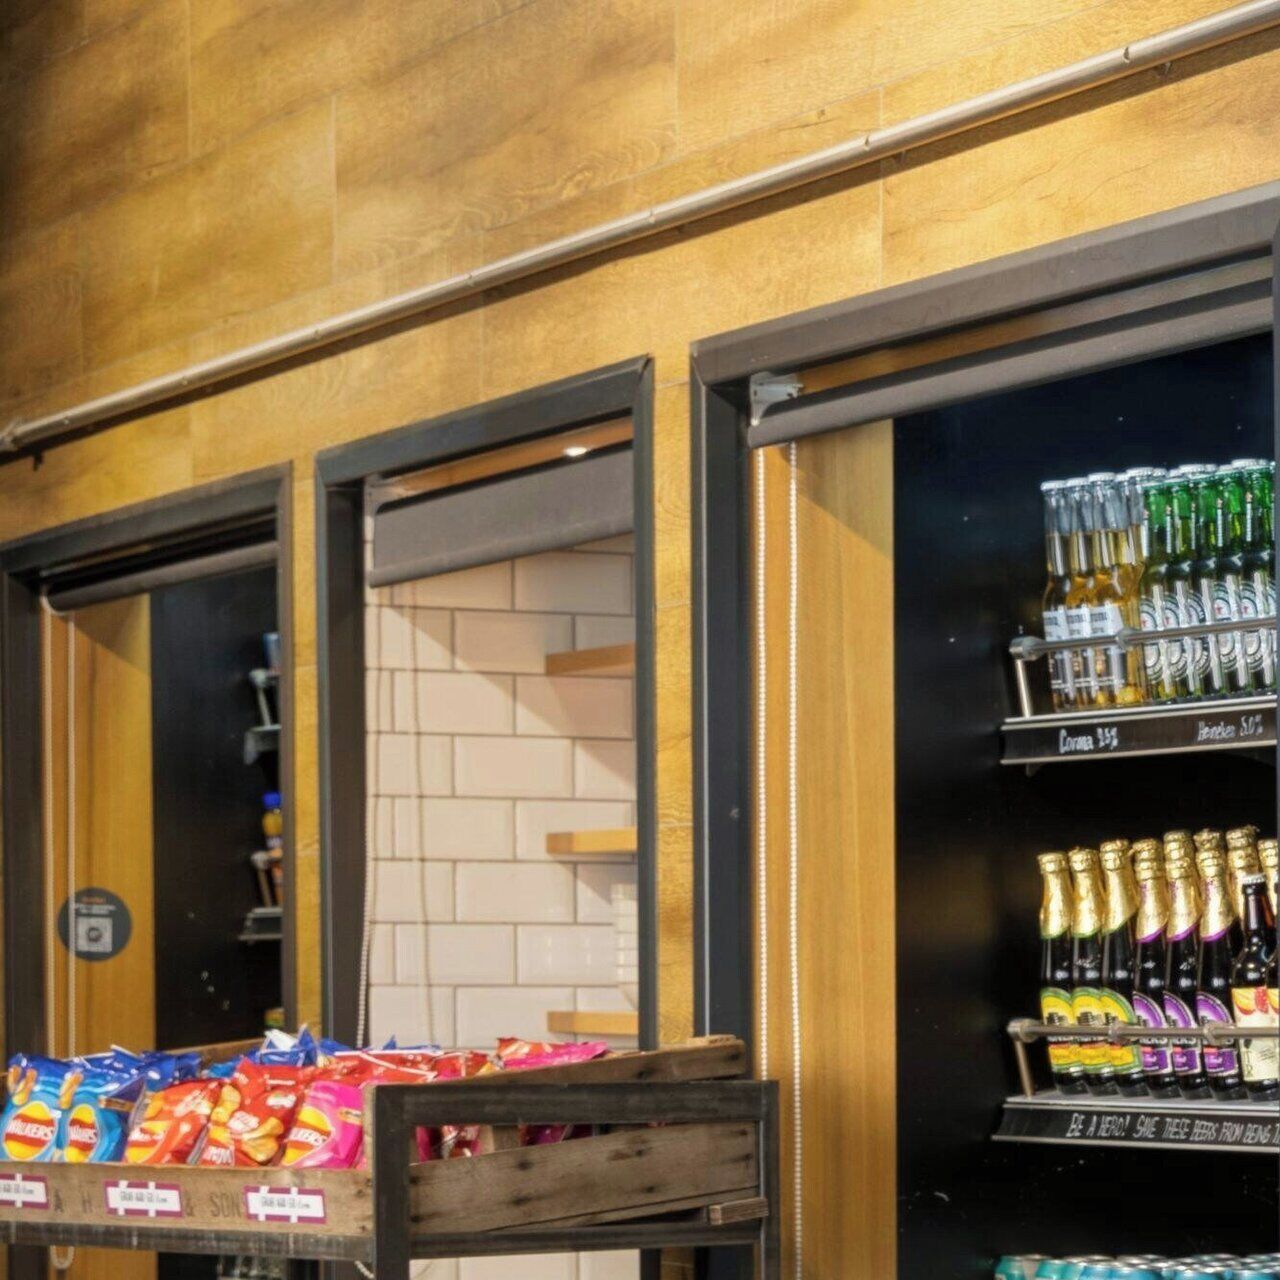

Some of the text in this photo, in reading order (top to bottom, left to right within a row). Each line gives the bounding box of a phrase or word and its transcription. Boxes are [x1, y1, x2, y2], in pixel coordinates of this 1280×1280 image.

[1065, 1112, 1086, 1138] BE
[1086, 1114, 1098, 1137] A
[1133, 1114, 1160, 1139] SAVE
[1162, 1117, 1189, 1140] THESE
[1189, 1118, 1217, 1142] BEERS
[1218, 1120, 1244, 1143] FROM
[1243, 1121, 1272, 1145] BEING
